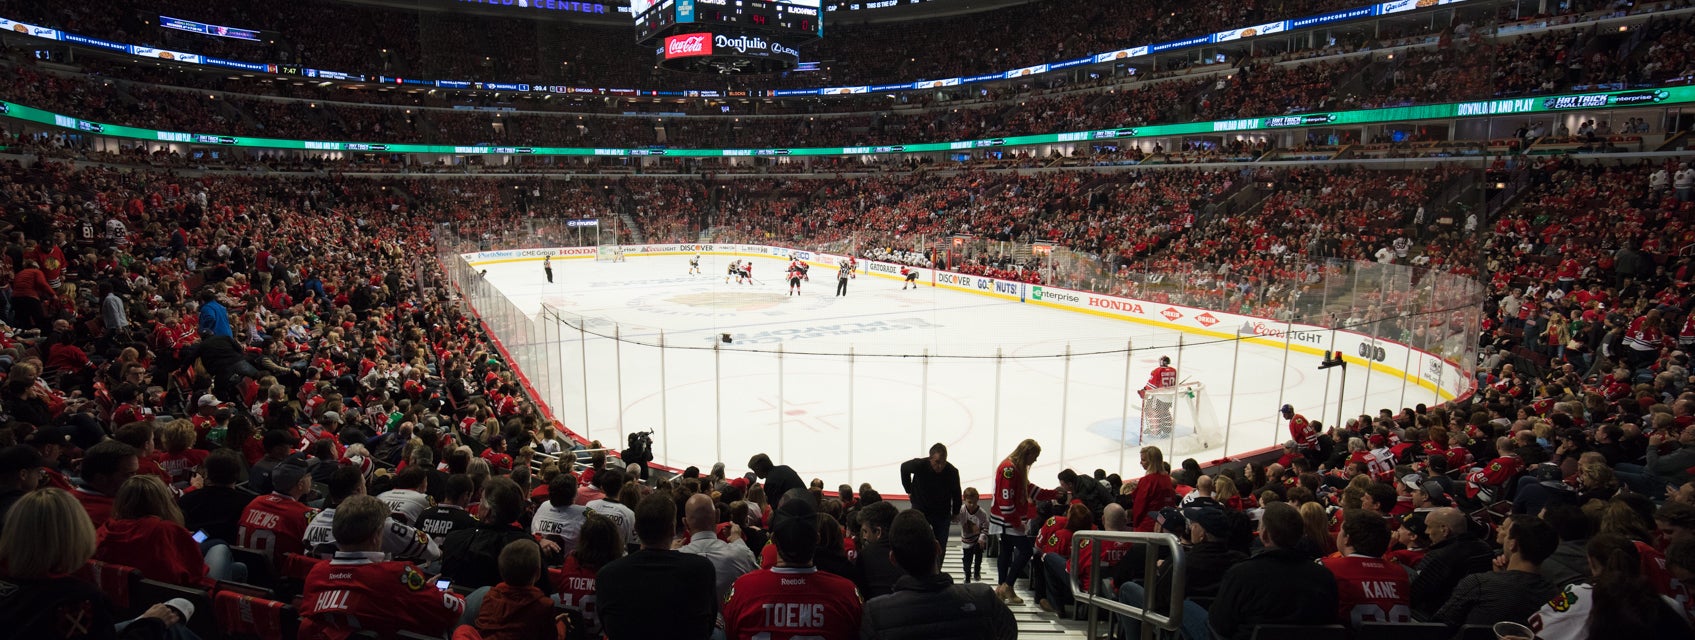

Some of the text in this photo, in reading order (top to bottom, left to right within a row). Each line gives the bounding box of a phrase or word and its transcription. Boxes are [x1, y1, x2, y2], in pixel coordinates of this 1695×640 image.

[533, 0, 604, 14] CENTER
[788, 6, 817, 16] BLACKHAWKS
[1320, 13, 1347, 22] POPCORN
[669, 36, 704, 54] Coca-Cola
[1498, 101, 1513, 113] AND
[1514, 98, 1534, 112] PLAY
[1214, 118, 1259, 131] DOWNLOAD AND PLAY
[83, 226, 94, 238] 81
[870, 263, 897, 274] GATORADE
[939, 273, 970, 286] DISCOVER
[996, 282, 1017, 294] NUTS!
[1034, 288, 1079, 303] enterprise
[1089, 297, 1144, 314] HONDA
[1163, 311, 1180, 319] ORKIN
[1197, 316, 1216, 325] ORKIN
[1253, 321, 1285, 339] Coors
[386, 500, 404, 511] ANE
[246, 509, 280, 530] TOEWS
[423, 518, 453, 534] SHARP
[307, 526, 332, 542] KANE
[539, 520, 563, 534] TOEWS
[1106, 550, 1127, 560] TOE
[781, 577, 806, 585] Reebok
[1362, 581, 1400, 599] KANE
[314, 589, 350, 612] HULL
[762, 603, 825, 628] TOEWS
